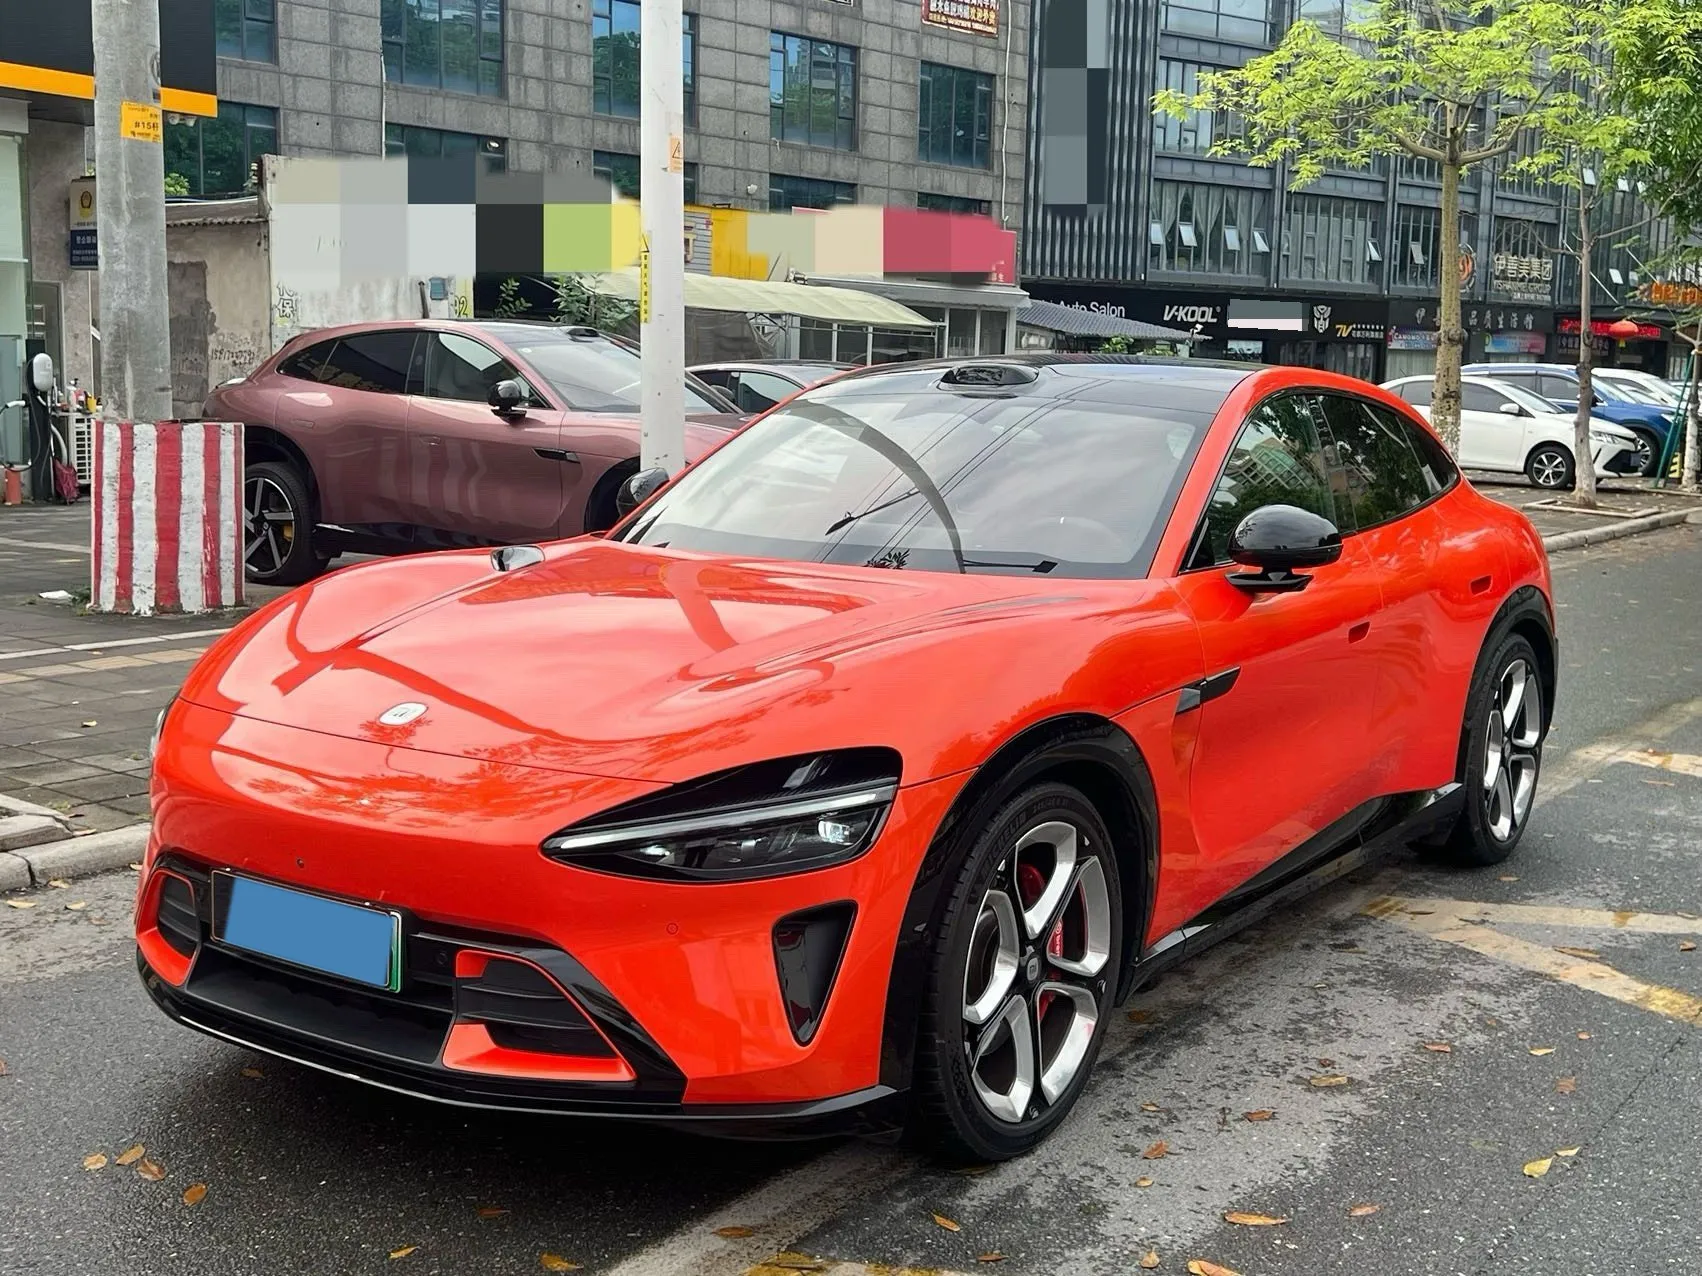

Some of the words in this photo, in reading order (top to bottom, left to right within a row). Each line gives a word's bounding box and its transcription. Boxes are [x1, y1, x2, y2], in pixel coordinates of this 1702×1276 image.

[1494, 253, 1553, 280] 伊善美集团
[1528, 282, 1552, 294] GROUP
[1090, 302, 1125, 317] Salon
